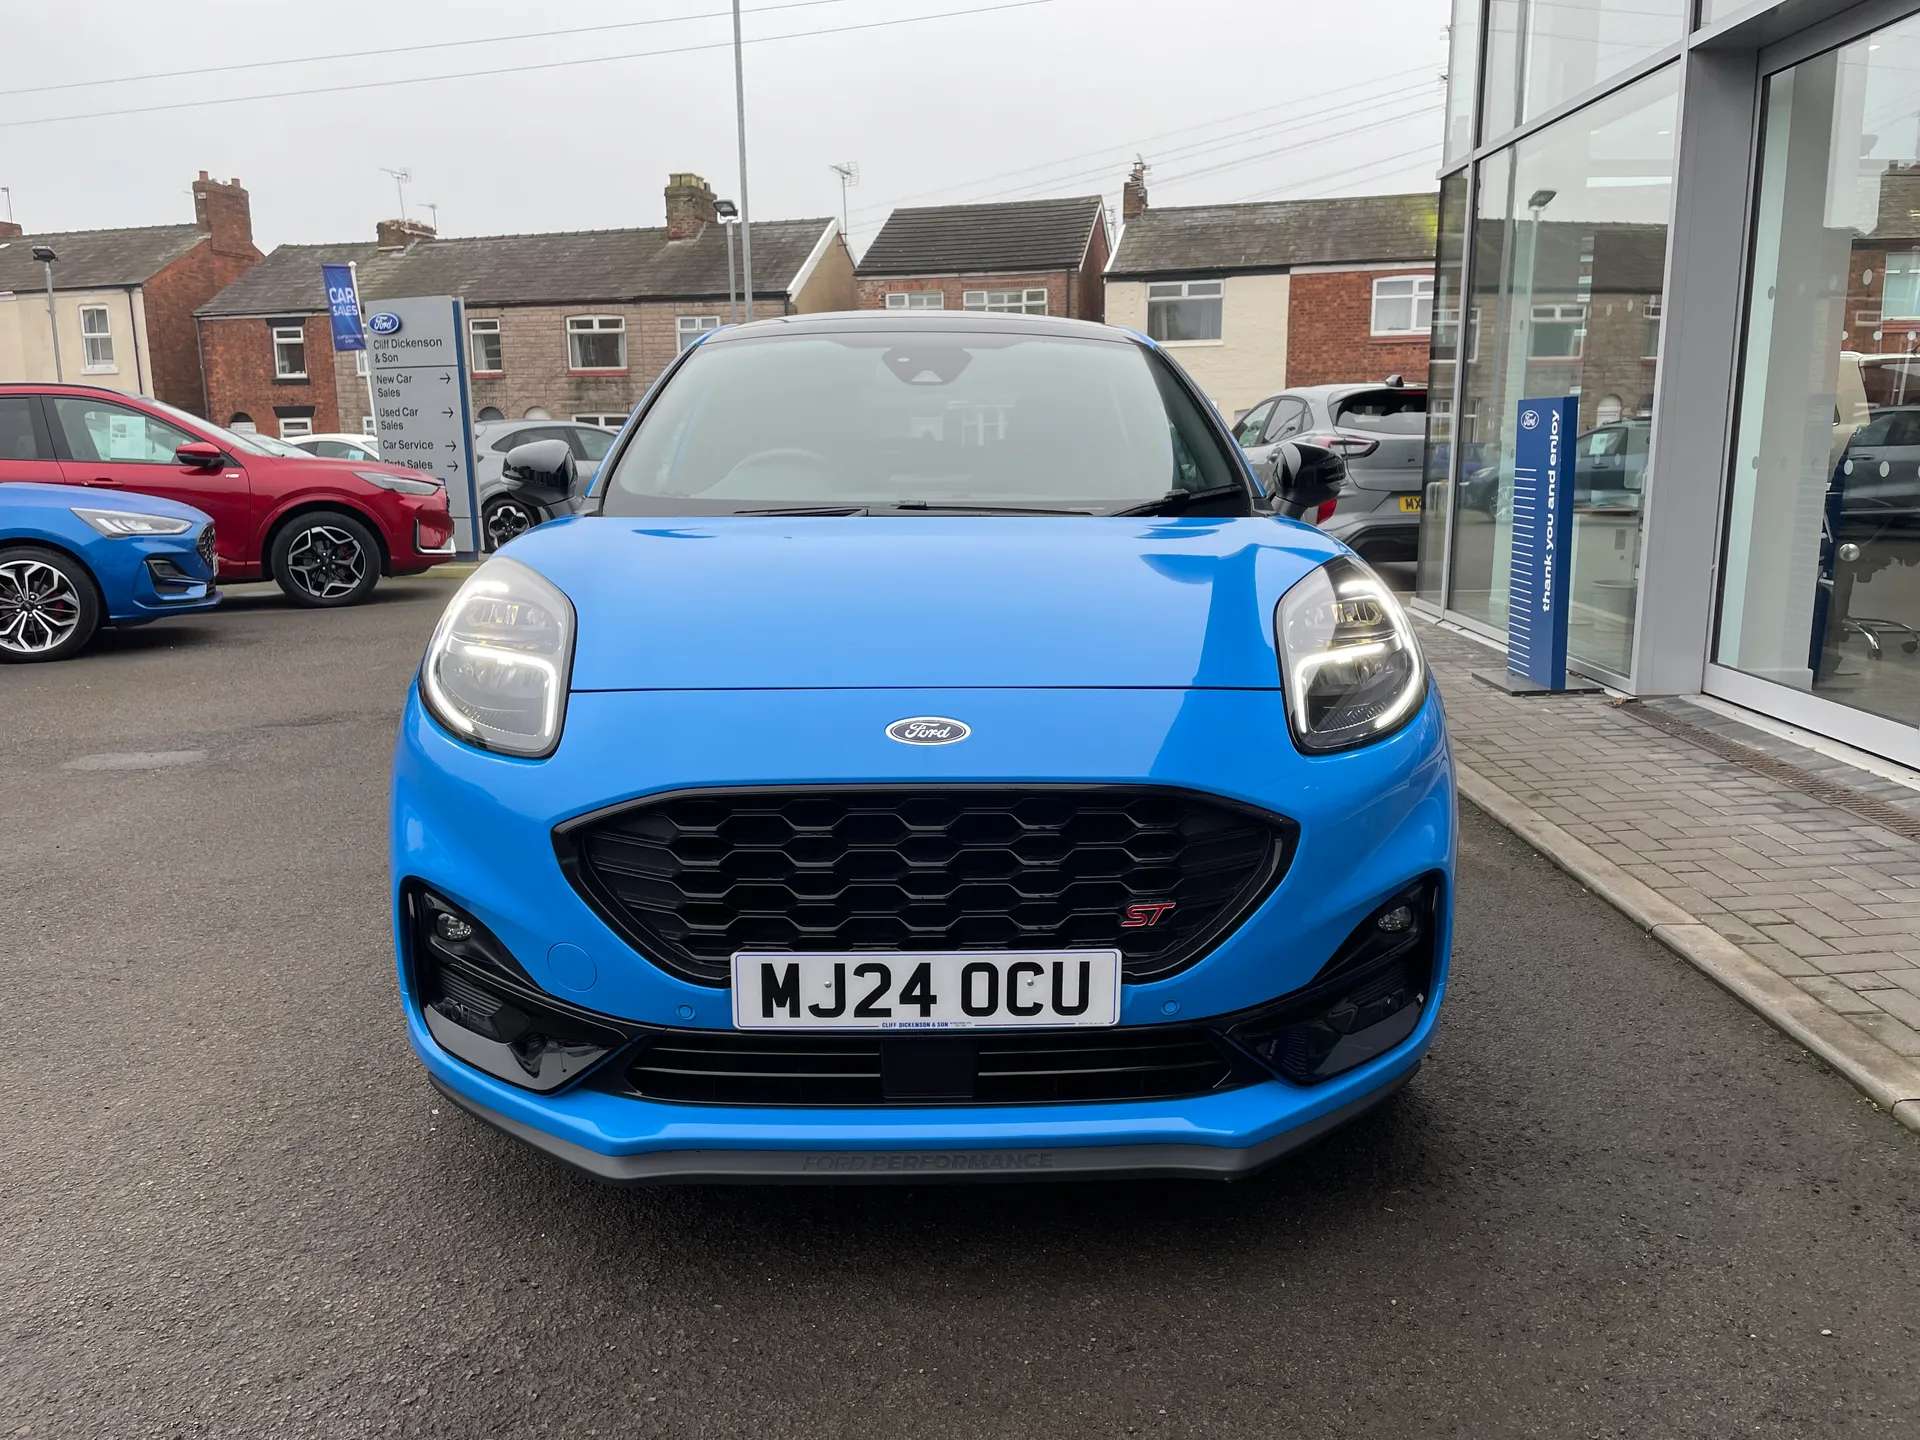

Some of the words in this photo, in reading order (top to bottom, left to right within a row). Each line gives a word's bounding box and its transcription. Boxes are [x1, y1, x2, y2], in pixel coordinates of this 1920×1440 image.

[329, 287, 355, 304] CAR
[333, 304, 358, 316] SALES
[374, 315, 393, 330] Ford
[373, 339, 390, 349] Cliff
[391, 337, 443, 348] Dickenson
[375, 354, 380, 363] &
[382, 353, 399, 362] Son
[376, 374, 394, 384] New
[396, 374, 412, 384] Car
[378, 387, 400, 398] Sales
[379, 407, 400, 417] Used
[402, 406, 419, 417] Car
[381, 420, 404, 431] Sales
[382, 440, 397, 449] Car
[398, 439, 434, 450] Service
[1549, 409, 1560, 466] enjoy
[407, 459, 433, 470] Sales
[1547, 470, 1556, 510] and
[1546, 513, 1554, 551] you
[1543, 554, 1552, 613] thank
[905, 722, 952, 738] Ford
[1120, 902, 1177, 927] ST
[760, 962, 938, 1018] MJ24
[960, 961, 1091, 1017] OCU
[871, 1151, 1053, 1170] PERFORMANCE
